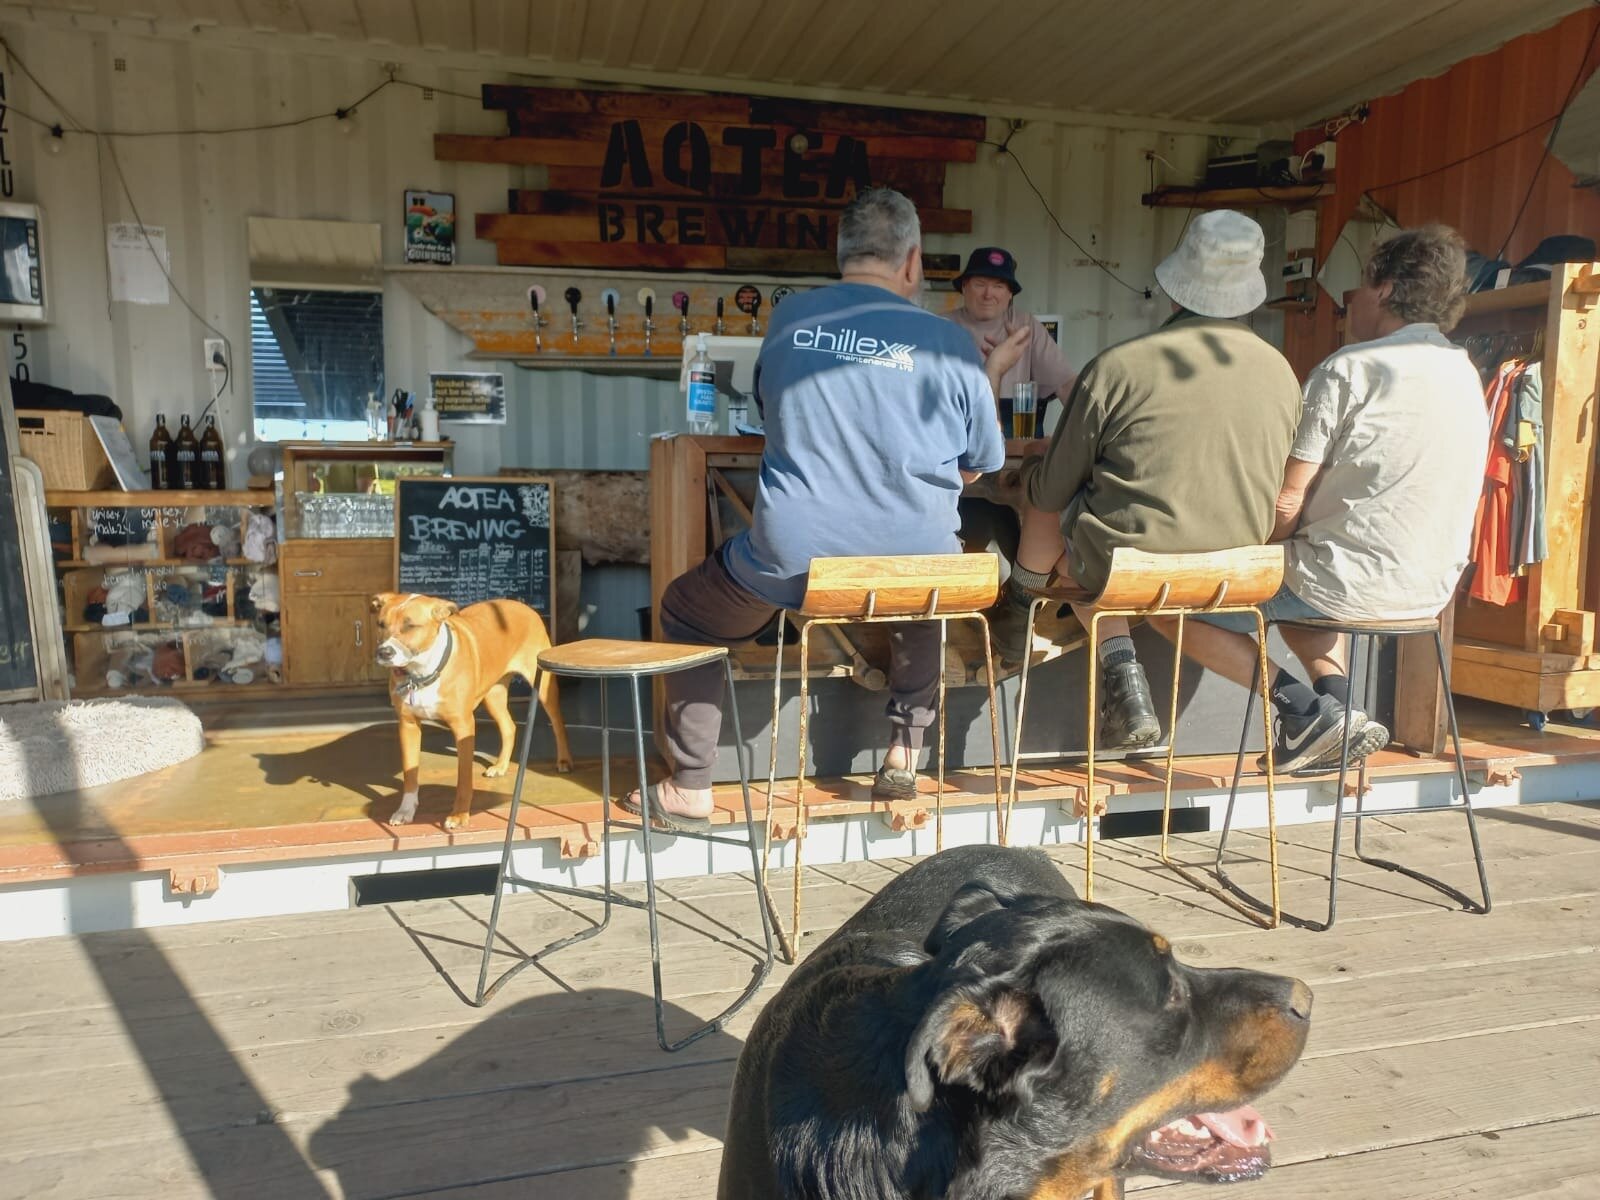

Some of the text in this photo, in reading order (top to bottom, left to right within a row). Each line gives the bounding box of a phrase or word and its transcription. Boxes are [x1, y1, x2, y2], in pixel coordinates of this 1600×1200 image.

[600, 119, 873, 200] AOTEA
[598, 204, 830, 249] BREWIN
[408, 249, 451, 261] GUINNESS
[793, 325, 906, 359] chillex
[438, 486, 516, 512] AOTEA
[408, 515, 527, 540] BREWING
